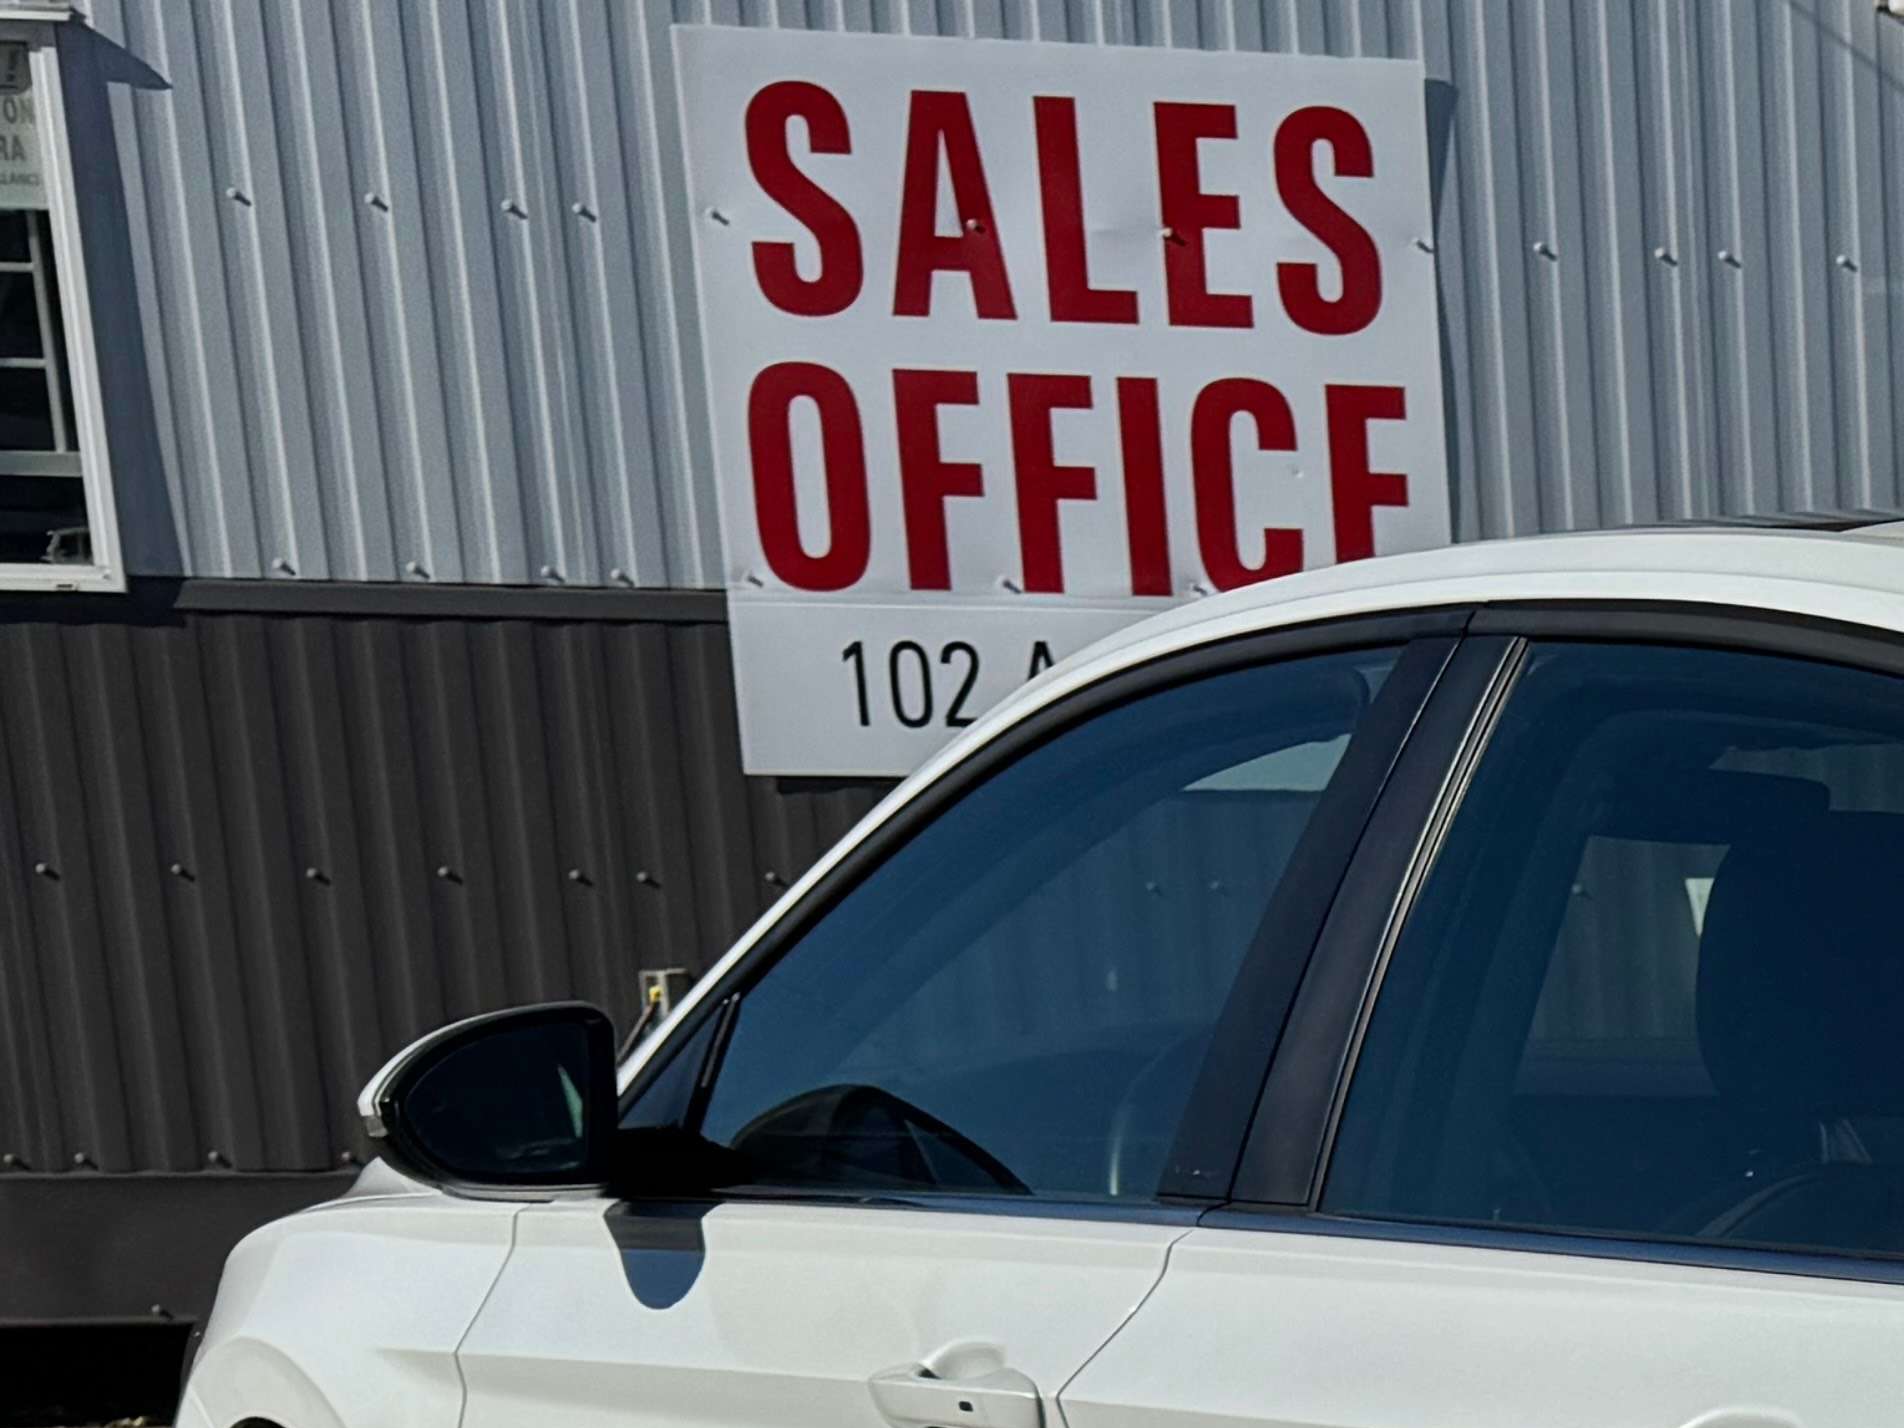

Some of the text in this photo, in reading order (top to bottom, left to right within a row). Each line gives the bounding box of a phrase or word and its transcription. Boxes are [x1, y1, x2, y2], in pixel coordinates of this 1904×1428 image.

[744, 79, 1384, 336] SALES
[747, 361, 1410, 597] OFFICE
[841, 640, 980, 728] 102
